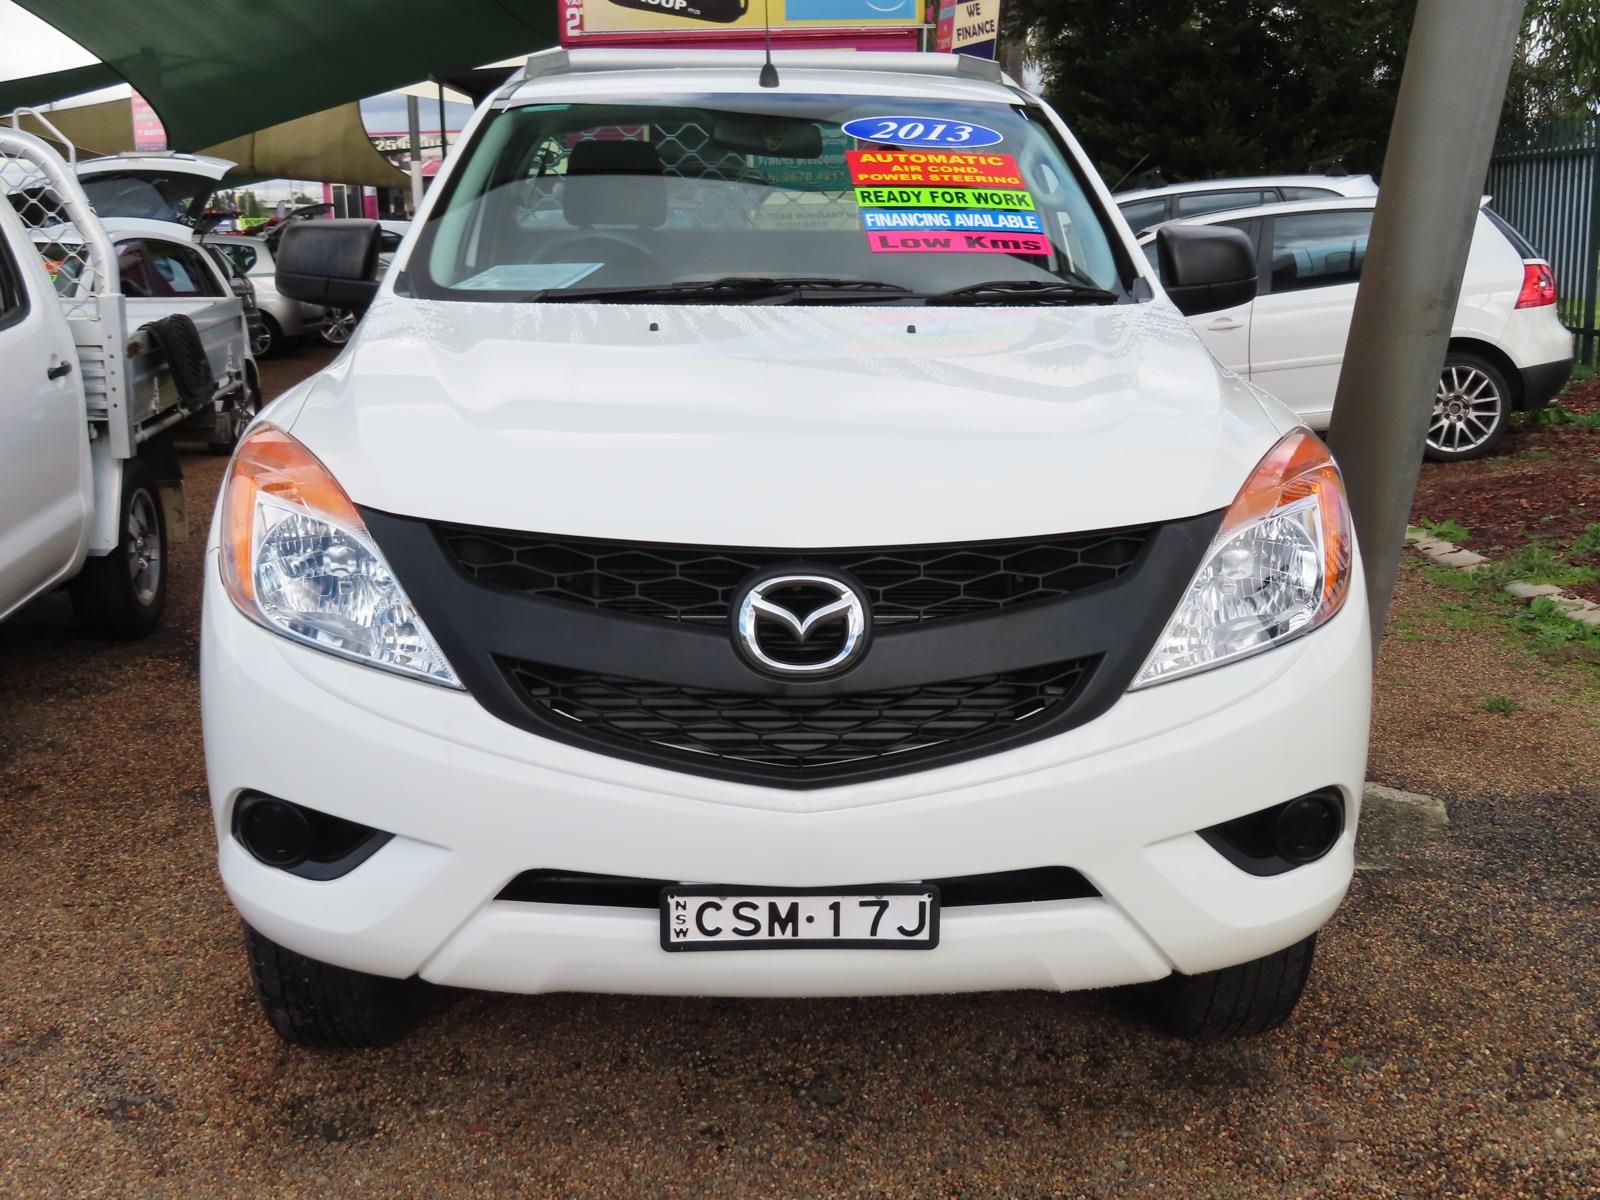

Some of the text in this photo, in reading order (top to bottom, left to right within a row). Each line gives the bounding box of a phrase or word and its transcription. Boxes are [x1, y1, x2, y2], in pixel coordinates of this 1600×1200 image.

[966, 3, 981, 17] WE
[956, 20, 995, 41] FINANCE
[869, 121, 974, 142] 2013
[860, 153, 1004, 166] AUTOMATIC
[927, 166, 984, 174] COND.
[858, 173, 1021, 184] POWER STEERING
[860, 190, 1031, 207] READY FOR WORK
[865, 213, 1039, 229] FINANCING AVAILABLE
[964, 236, 1042, 250] Kms
[674, 900, 689, 938] NSW
